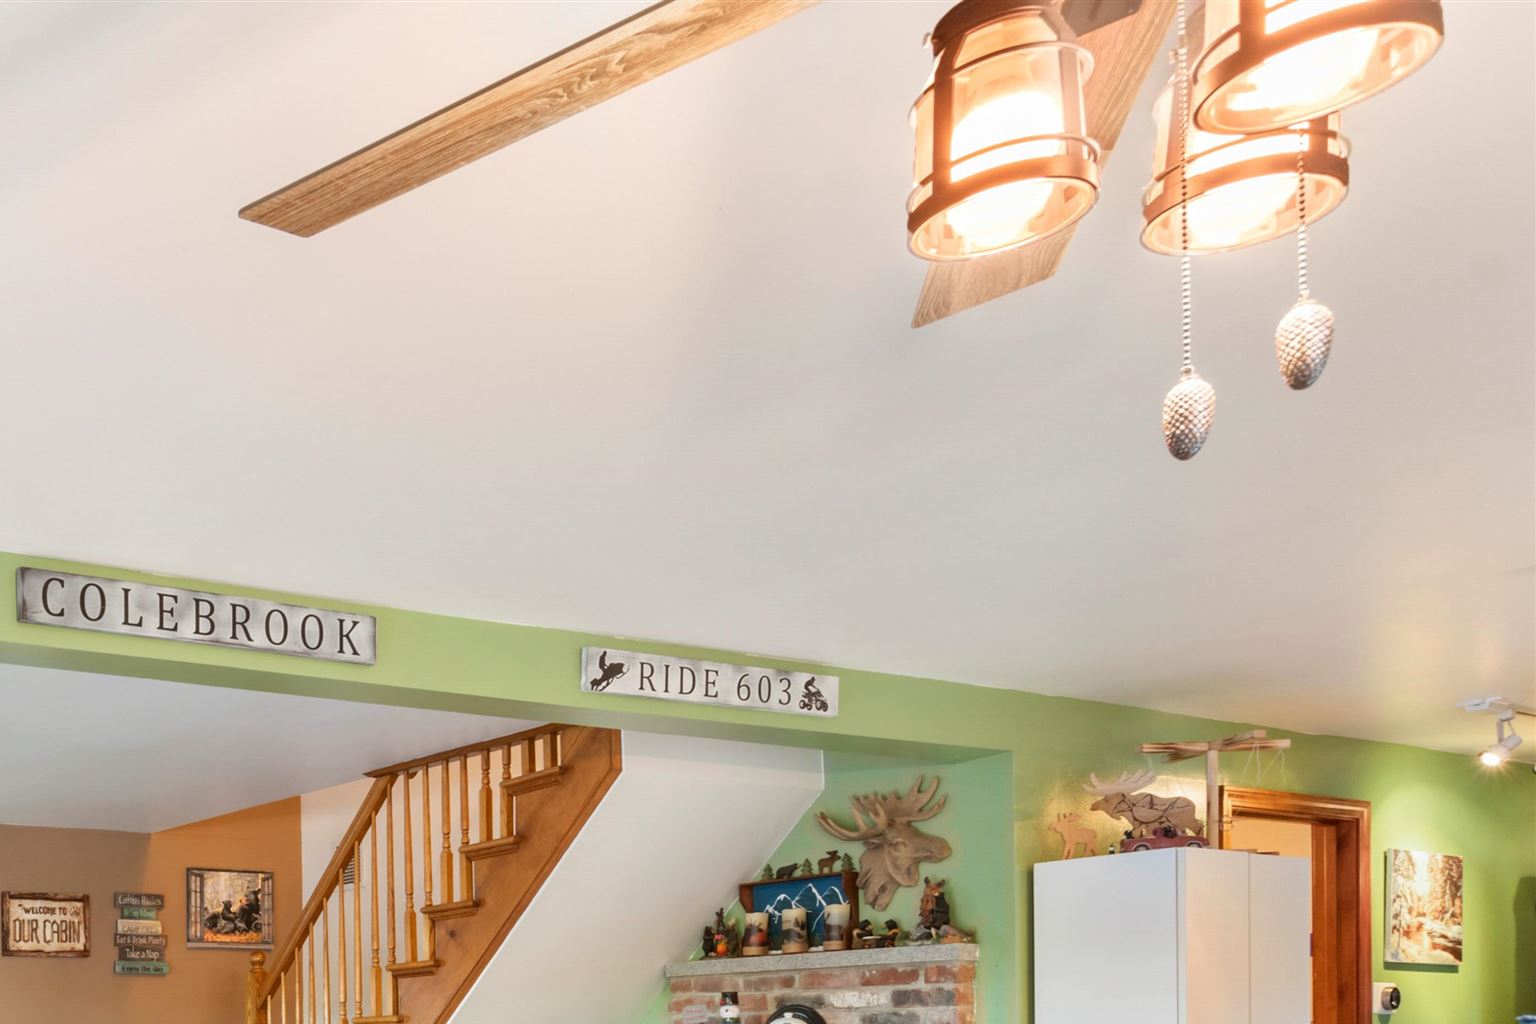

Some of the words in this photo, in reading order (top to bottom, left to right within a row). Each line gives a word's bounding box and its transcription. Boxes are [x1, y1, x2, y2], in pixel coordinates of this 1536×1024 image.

[41, 577, 361, 656] COLEBROOK
[638, 661, 720, 698] RIDE
[736, 673, 792, 705] 603
[23, 906, 57, 916] WELCOME
[58, 907, 68, 915] TO
[13, 918, 40, 944] OUR
[43, 919, 82, 944] CABIN
[125, 946, 140, 958] Take
[146, 949, 160, 962] Nap
